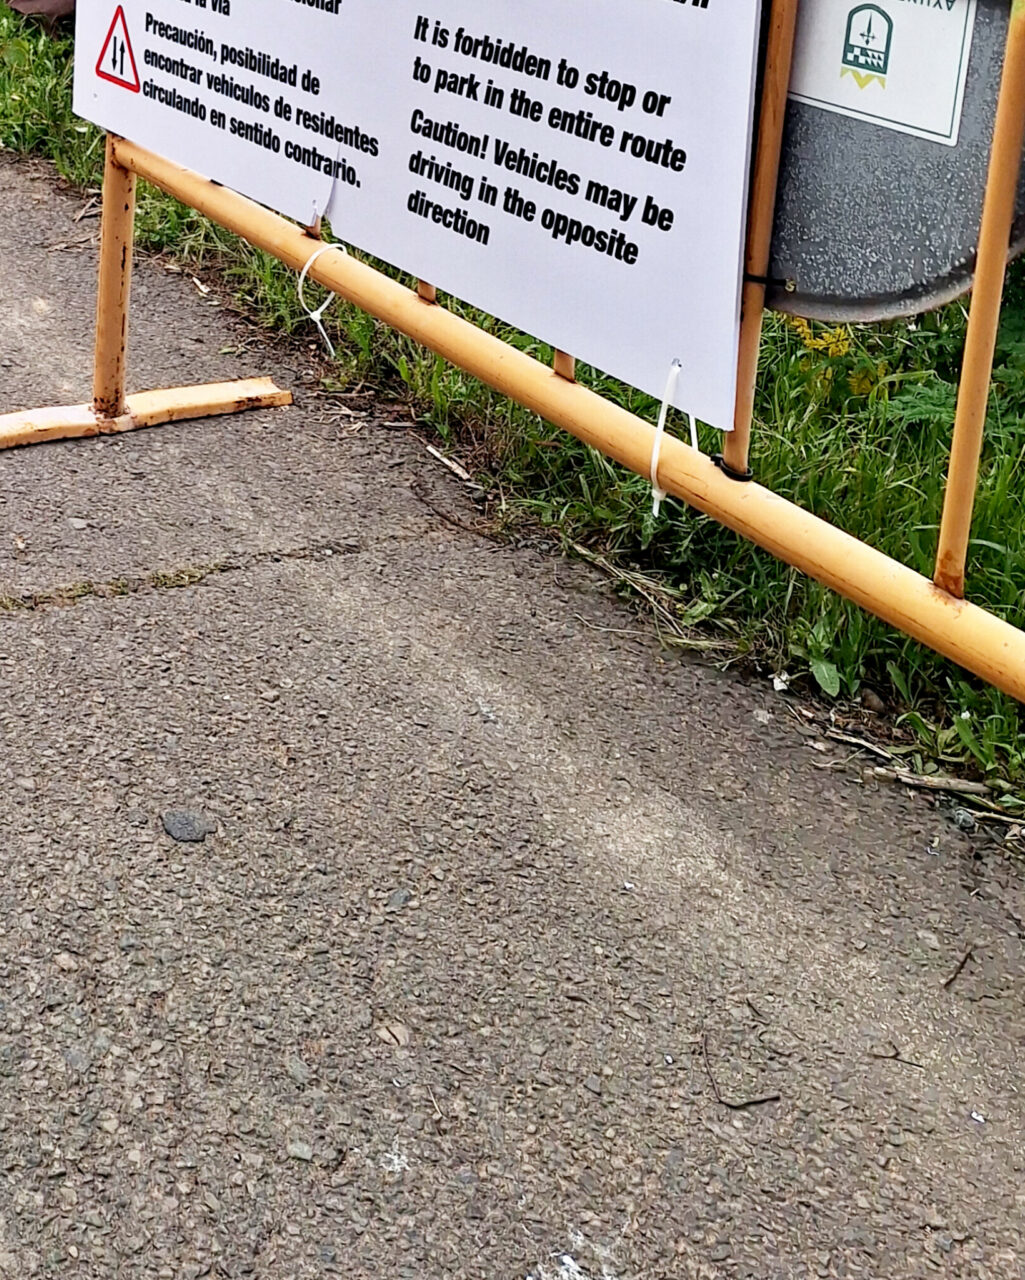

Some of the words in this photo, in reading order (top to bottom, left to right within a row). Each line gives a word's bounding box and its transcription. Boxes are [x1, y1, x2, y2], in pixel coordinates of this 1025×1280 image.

[144, 49, 202, 84] encontrar
[206, 72, 269, 112] vehiculos
[274, 96, 291, 121] de
[296, 108, 378, 156] residentes
[145, 12, 216, 61] Precaución,
[220, 44, 296, 86] posibilidad
[301, 69, 319, 95] de
[414, 15, 428, 42] It
[432, 20, 449, 47] is
[454, 27, 550, 80] forbidden
[556, 58, 578, 88] to
[584, 71, 636, 111] stop
[642, 91, 671, 116] or
[143, 78, 205, 120] circulando
[210, 109, 225, 129] en
[229, 117, 280, 152] sentido
[284, 141, 360, 187] contrario.
[413, 56, 430, 83] to
[434, 69, 480, 100] park
[484, 79, 503, 109] in
[509, 88, 542, 121] the
[548, 107, 614, 146] entire
[619, 131, 686, 171] route
[407, 190, 489, 245] direction
[408, 150, 474, 200] driving
[478, 176, 497, 206] in
[503, 187, 536, 221] the
[541, 208, 638, 264] opposite
[410, 109, 489, 159] Caution!
[494, 138, 580, 194] Vehicles
[585, 180, 637, 221] may
[641, 195, 673, 231] be
